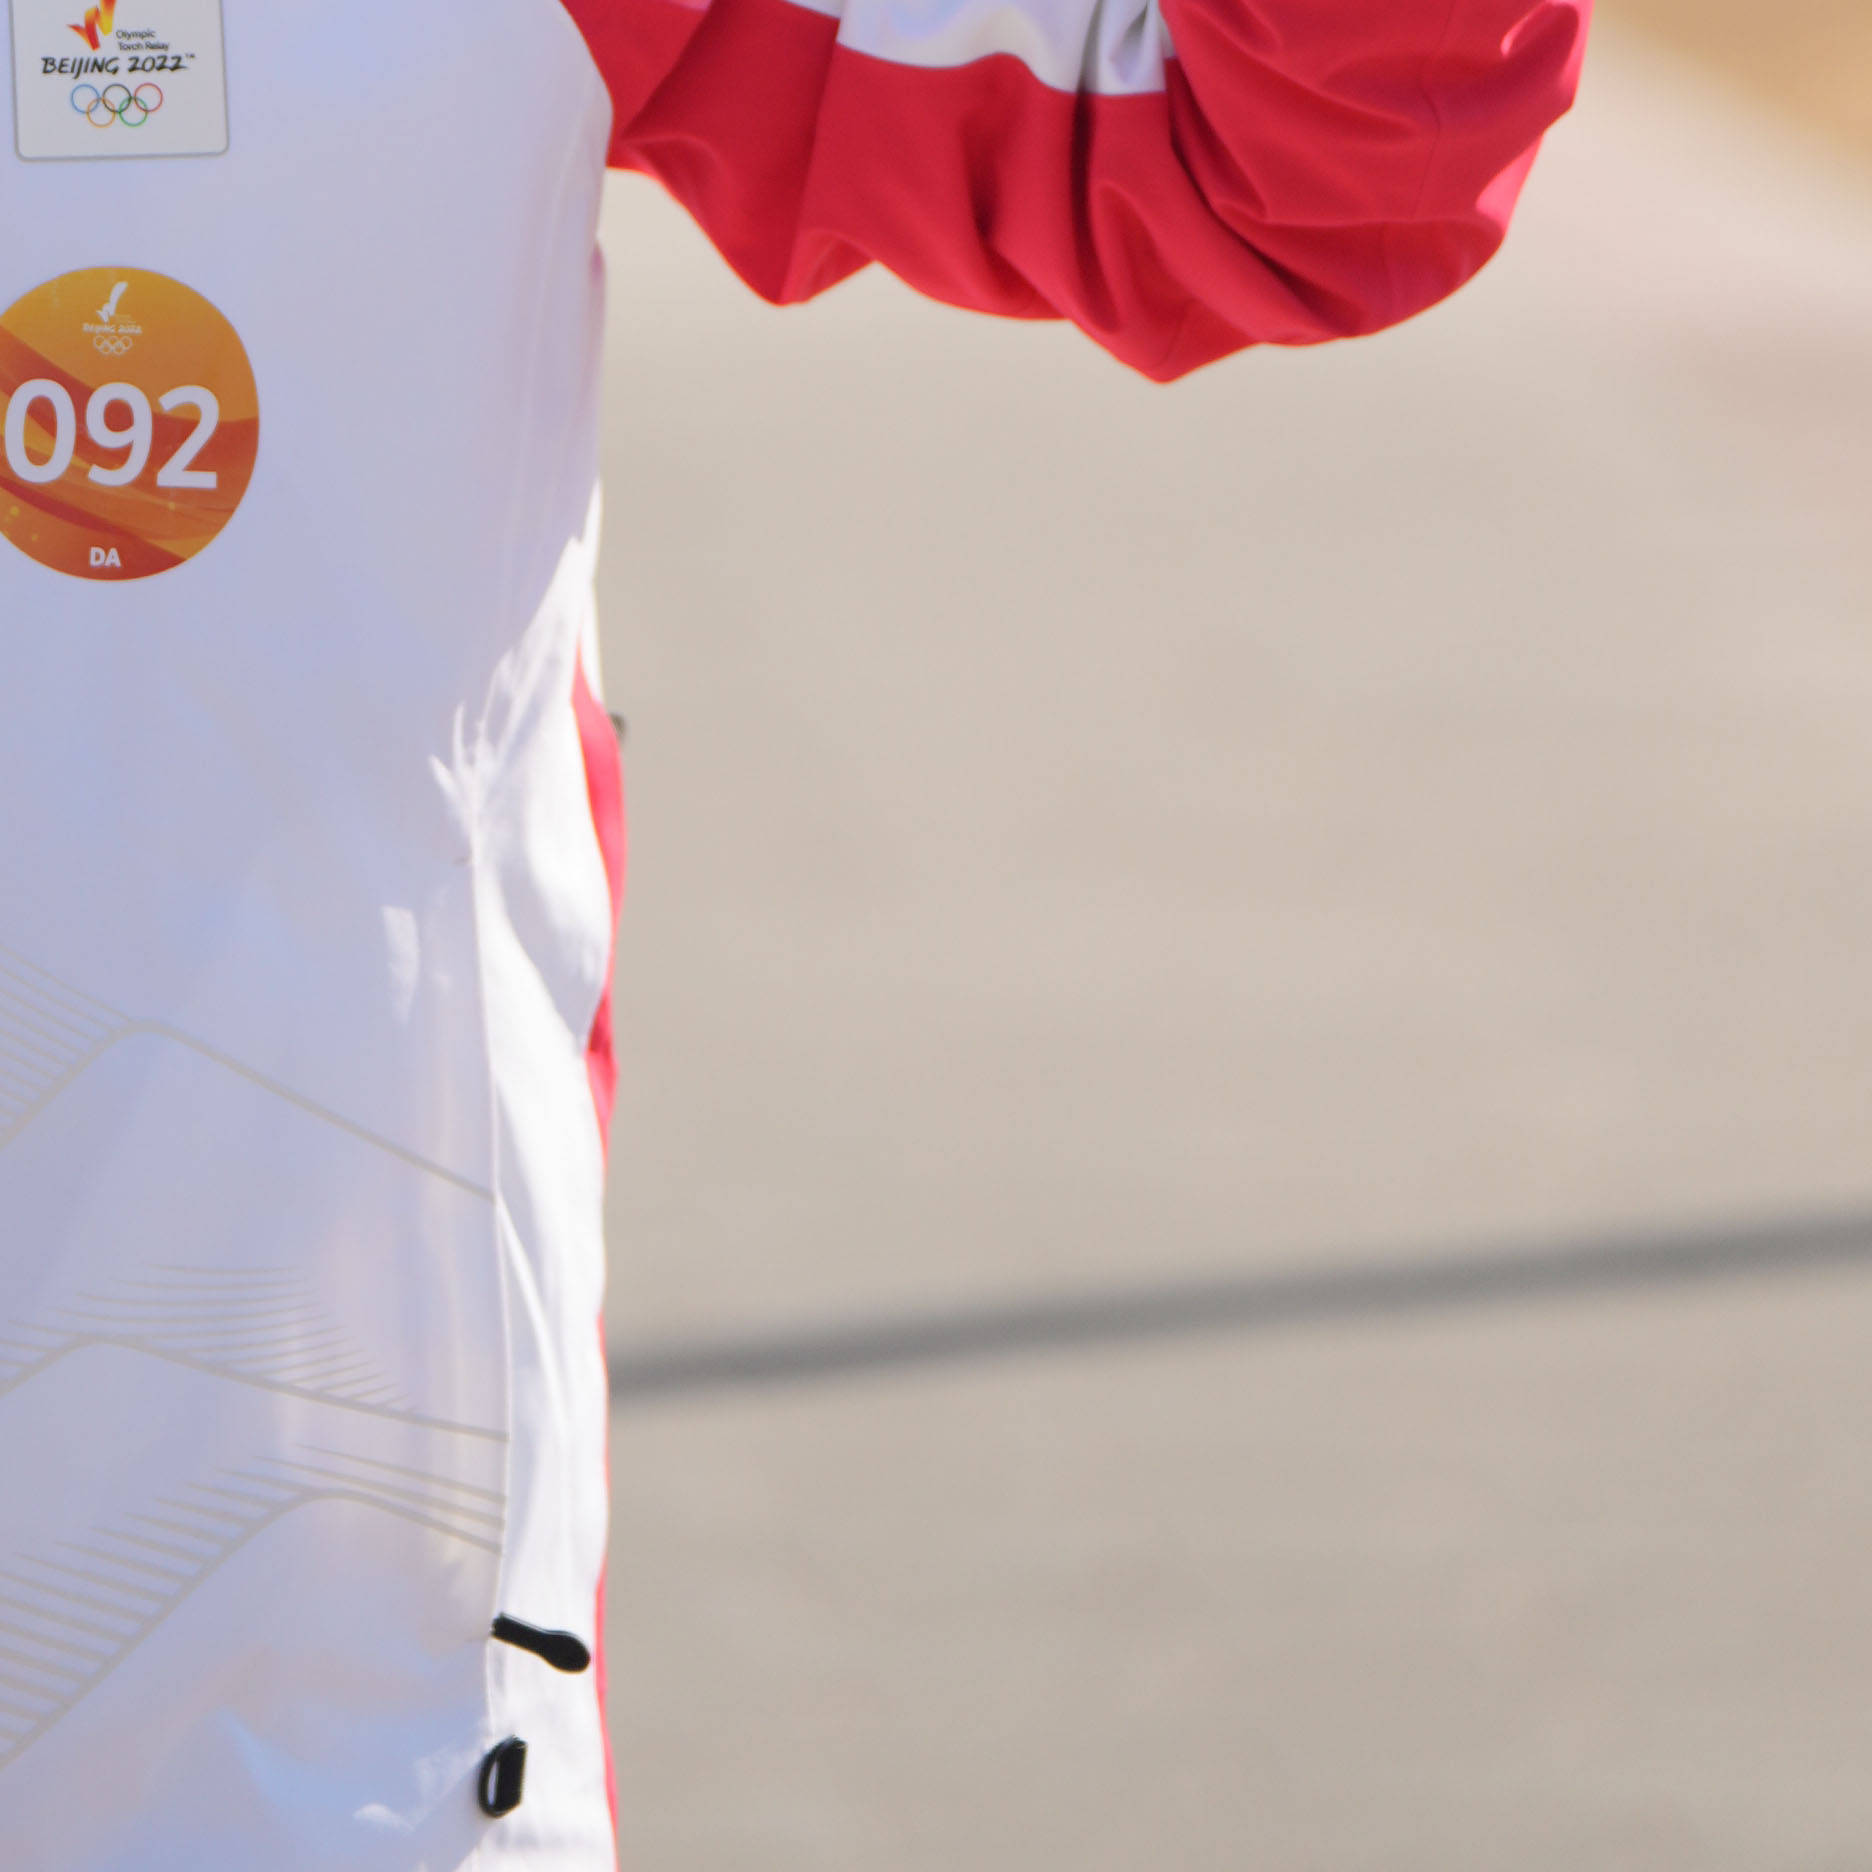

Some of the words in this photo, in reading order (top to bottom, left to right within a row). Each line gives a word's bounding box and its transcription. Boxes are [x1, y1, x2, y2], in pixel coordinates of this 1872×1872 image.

[115, 29, 156, 40] Olympic
[118, 41, 144, 51] Torch
[144, 40, 169, 52] Relay
[41, 56, 120, 79] BEIJING
[4, 377, 220, 489] 092
[89, 547, 121, 567] DA
